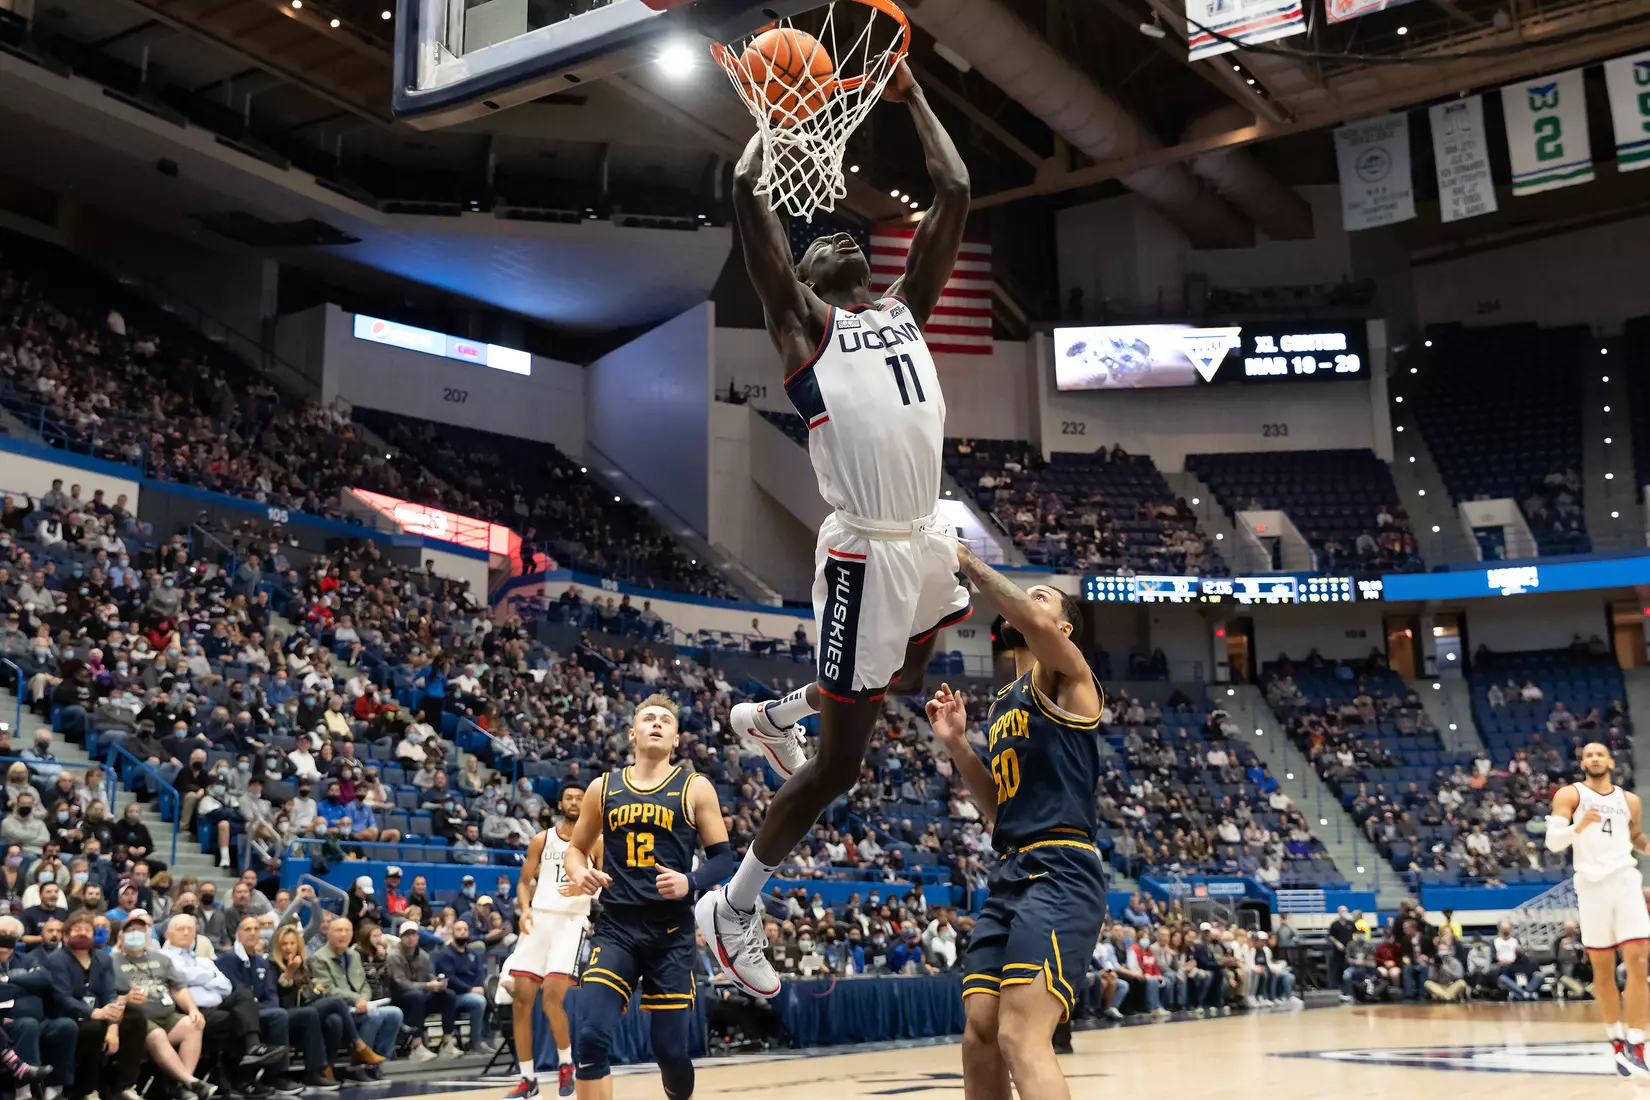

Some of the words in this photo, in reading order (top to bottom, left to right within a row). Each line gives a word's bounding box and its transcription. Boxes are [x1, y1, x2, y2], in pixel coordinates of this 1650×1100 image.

[1533, 115, 1564, 162] 2
[839, 322, 919, 352] UCONN
[1254, 336, 1278, 353] XL
[1245, 356, 1288, 375] MAR
[885, 354, 926, 405] 11
[443, 388, 469, 404] 207
[744, 384, 767, 398] 231
[1061, 421, 1086, 435] 232
[1262, 423, 1288, 437] 233
[268, 507, 289, 523] 105
[825, 566, 850, 681] HUSKIES
[957, 629, 976, 638] 107
[991, 747, 1020, 805] 50
[608, 803, 674, 832] COPPIN
[1601, 818, 1612, 837] 4
[626, 832, 655, 867] 12
